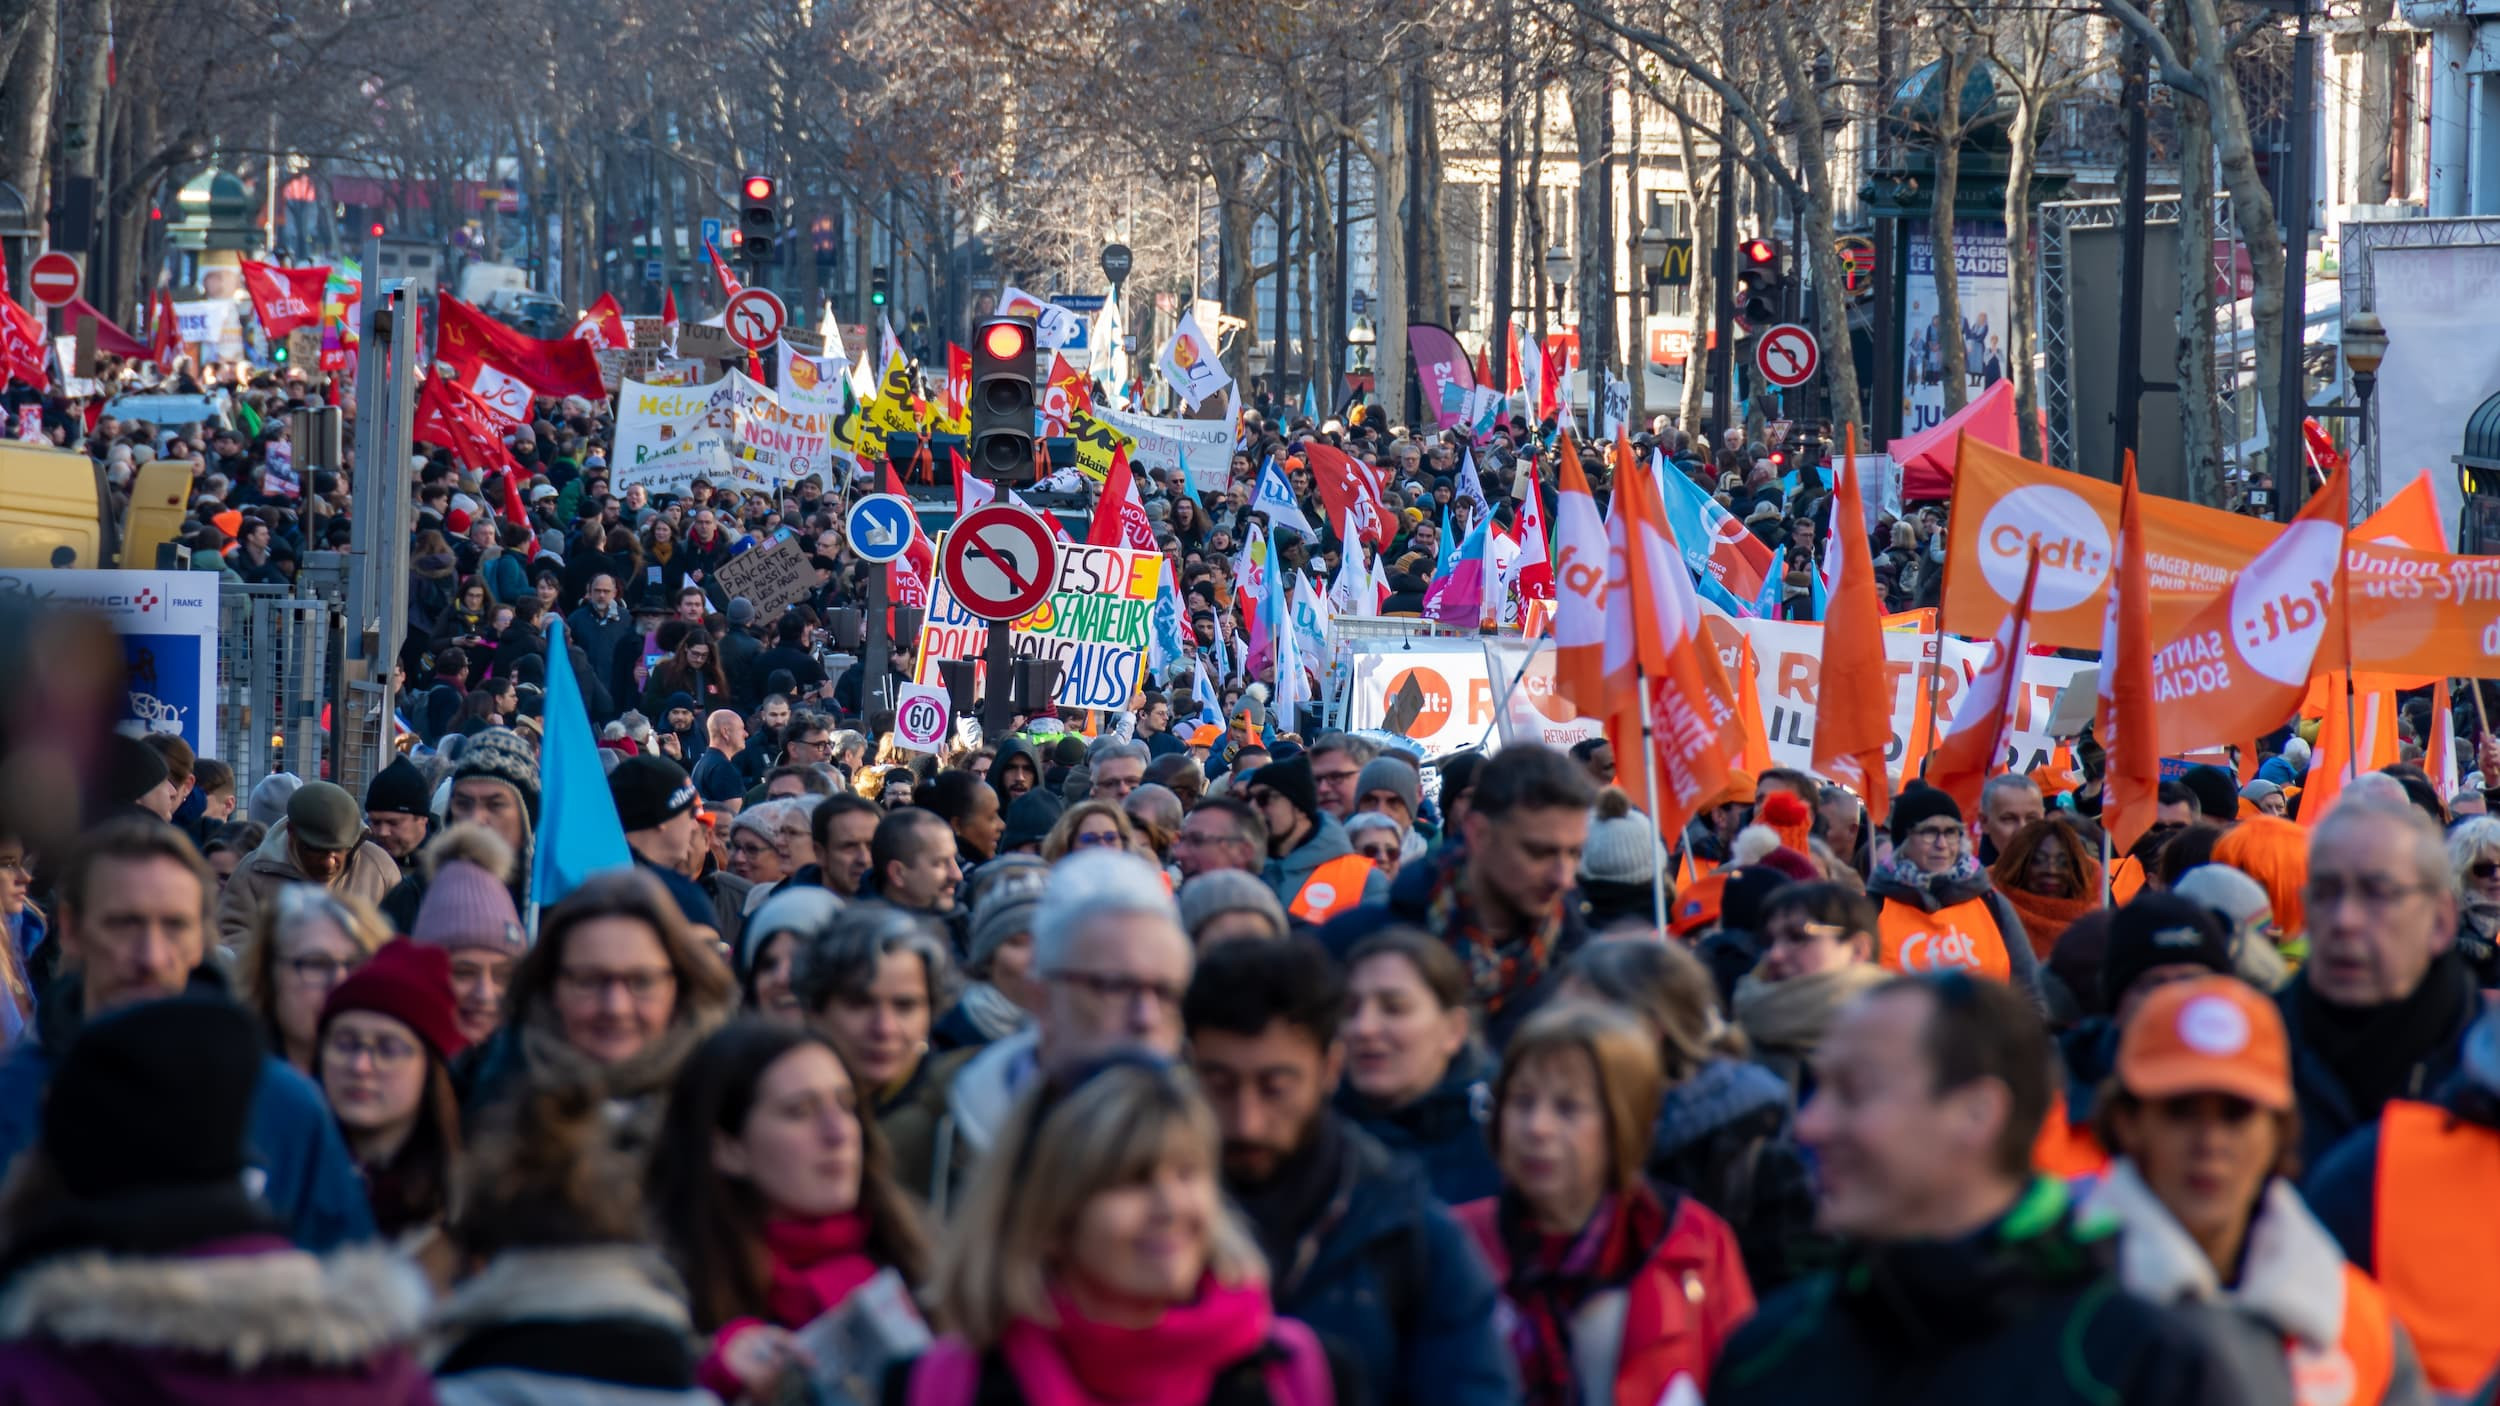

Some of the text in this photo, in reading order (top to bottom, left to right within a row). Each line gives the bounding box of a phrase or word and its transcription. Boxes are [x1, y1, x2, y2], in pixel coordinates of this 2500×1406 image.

[706, 223, 716, 238] P
[1910, 245, 1933, 255] POU
[1910, 258, 1926, 271] LE
[638, 394, 708, 418] Métr
[745, 421, 792, 455] NON
[719, 548, 767, 583] CETTE
[723, 547, 790, 595] PANCARTE
[1103, 549, 1155, 600] DE
[2192, 565, 2227, 585] POUR
[2347, 549, 2440, 578] Union
[2150, 574, 2187, 592] POUR
[172, 598, 204, 608] FRANCE
[1061, 643, 1143, 707] AUSSI
[909, 704, 935, 731] 60
